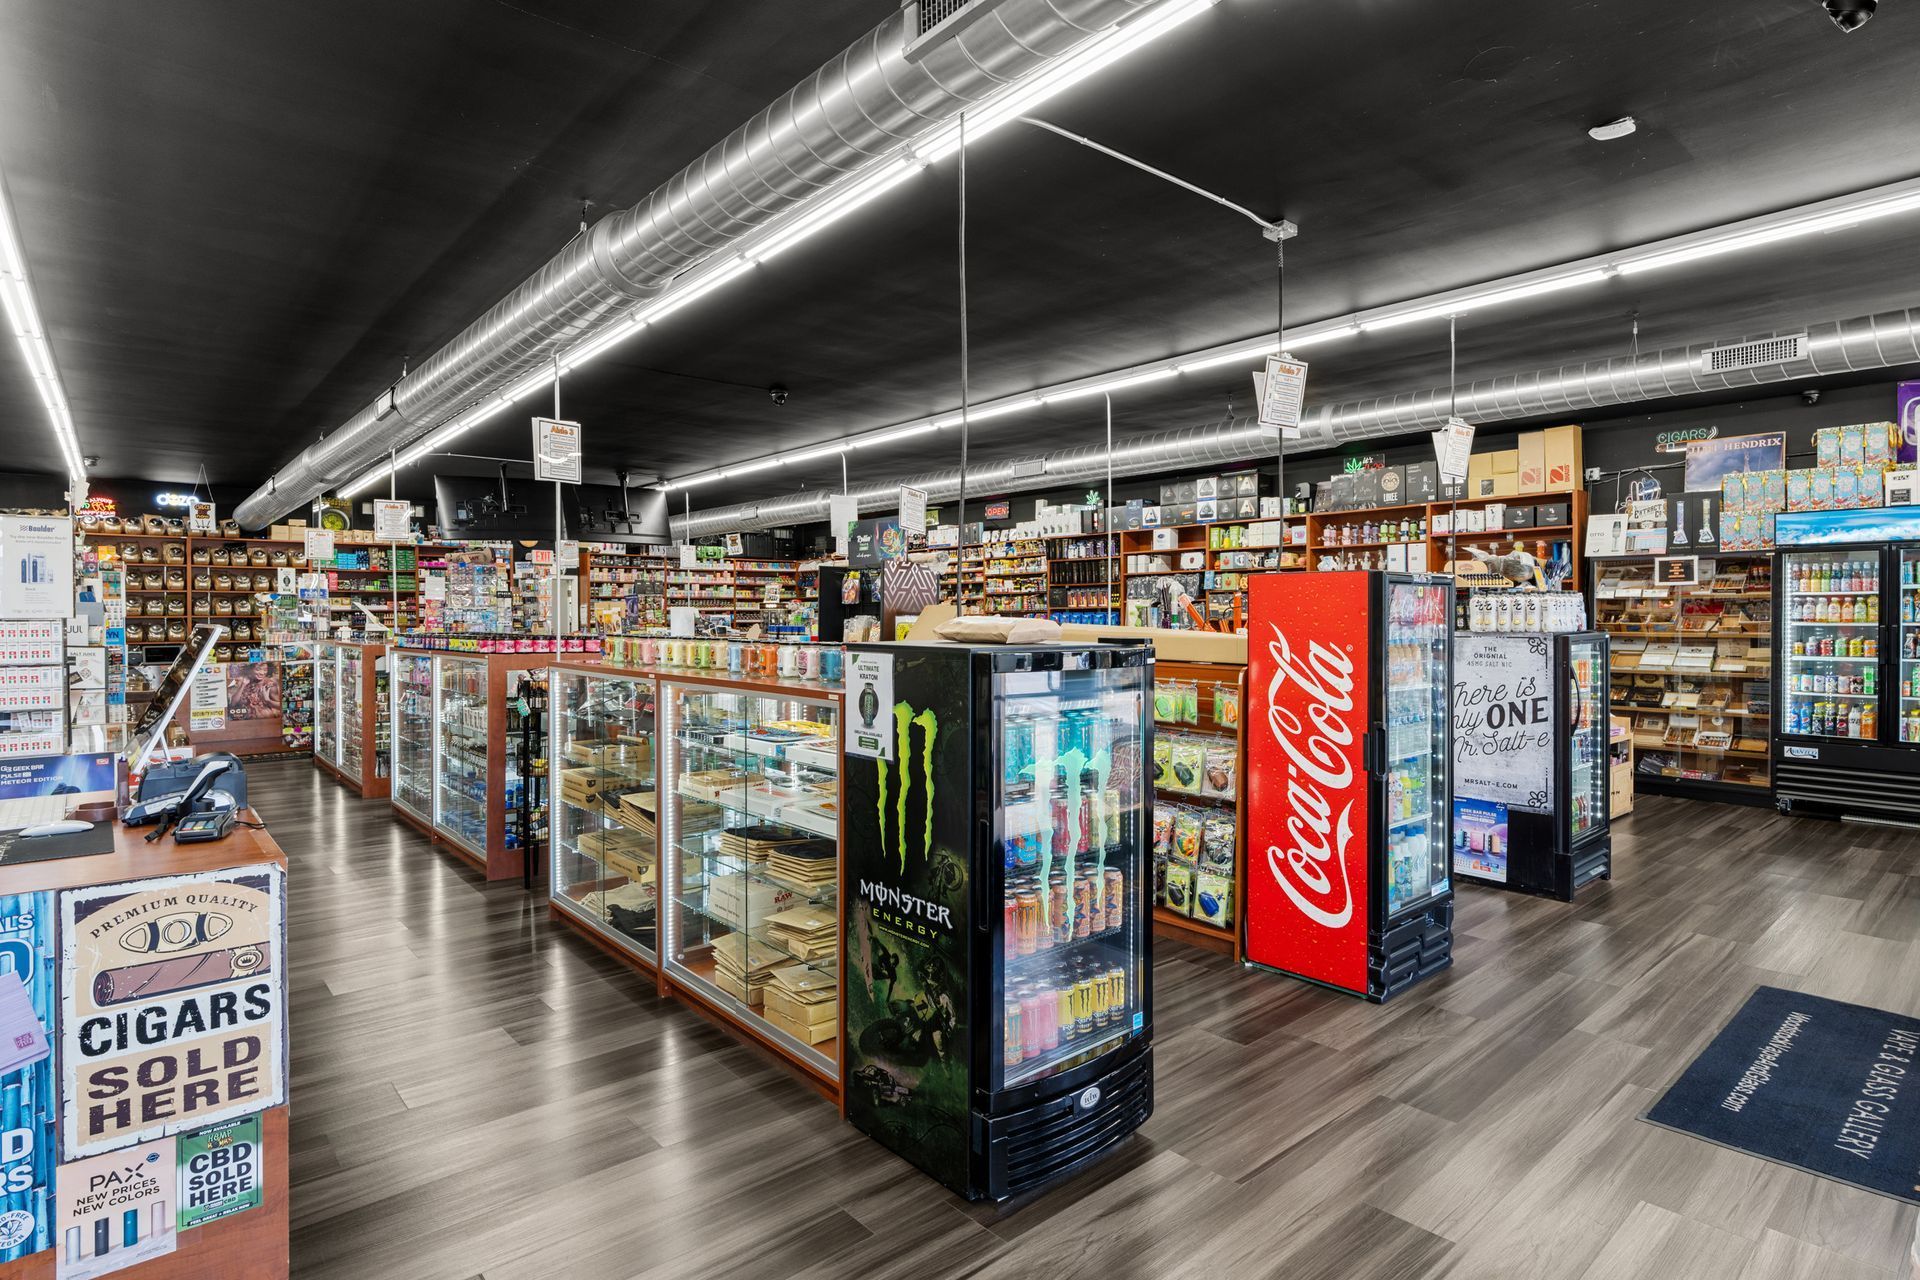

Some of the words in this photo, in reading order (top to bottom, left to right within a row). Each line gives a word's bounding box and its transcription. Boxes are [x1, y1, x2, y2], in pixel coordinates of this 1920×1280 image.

[1658, 429, 1707, 443] CIGARS
[1724, 438, 1782, 451] HENDRIX
[987, 508, 1007, 516] OPEN
[536, 551, 551, 562] EXIT
[859, 673, 878, 681] KRATOM
[1485, 660, 1499, 668] SALT
[1516, 676, 1537, 699] is
[1453, 708, 1484, 737] nly
[1486, 696, 1549, 730] ONE
[33, 775, 64, 783] EDITION
[1268, 621, 1353, 929] Coca-Cola
[1464, 778, 1518, 790] MRSALT-E.COM
[774, 892, 793, 904] RAW
[860, 878, 953, 930] MONSTER
[90, 896, 178, 939] PREMIUM
[186, 894, 259, 913] QUALITY
[873, 908, 938, 939] ENERGY
[78, 984, 271, 1057] CIGARS
[1882, 1028, 1920, 1055] VAPE
[88, 1035, 261, 1100] SOLD
[1878, 1052, 1911, 1063] &
[1862, 1063, 1906, 1101] GLASS
[89, 1066, 260, 1137] HERE
[199, 1128, 213, 1136] NOW
[213, 1121, 241, 1132] AVAILABLE
[1834, 1100, 1890, 1159] GALLERY
[189, 1143, 252, 1174] CBD
[90, 1163, 144, 1193] PAX
[189, 1162, 252, 1191] SOLD
[73, 1202, 105, 1217] NEW
[109, 1186, 160, 1206] COLORS
[77, 1191, 108, 1206] NEW
[113, 1177, 157, 1196] PRICES
[190, 1176, 252, 1208] HERE
[239, 1203, 251, 1211] NOW
